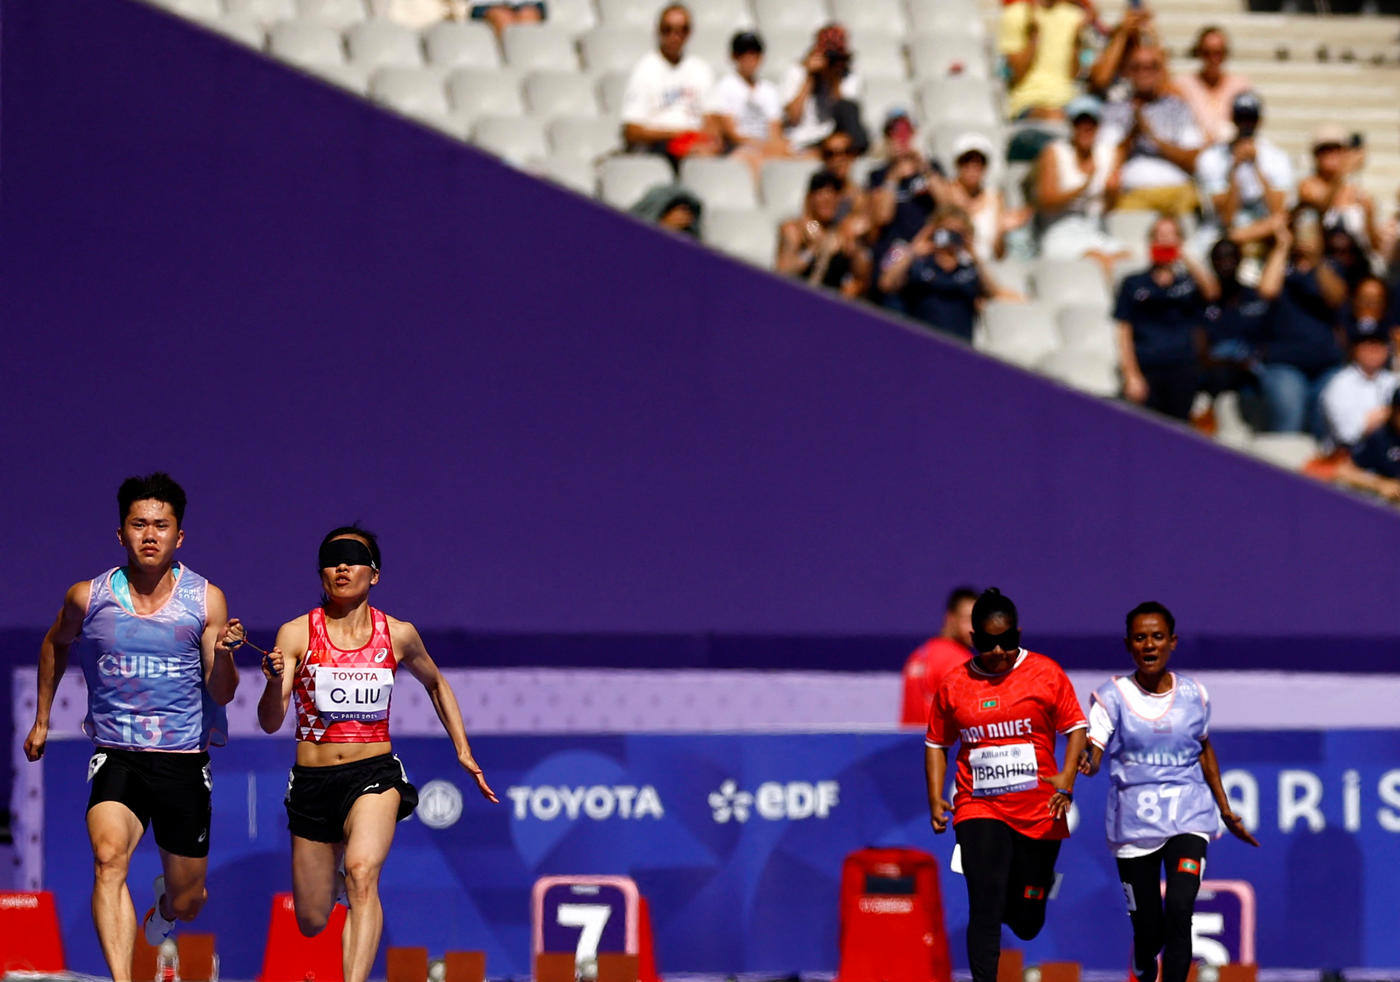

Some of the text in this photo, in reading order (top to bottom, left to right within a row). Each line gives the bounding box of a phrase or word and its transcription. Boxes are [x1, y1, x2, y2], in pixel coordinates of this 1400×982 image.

[97, 653, 182, 679] GUIDE
[331, 671, 379, 681] TOYOTA
[330, 688, 381, 704] C. LIU
[114, 712, 163, 747] 13
[981, 750, 1009, 760] Allianz
[974, 762, 1036, 781] IBRAHIM
[507, 784, 665, 820] TOYOTA
[1136, 786, 1183, 823] 87
[556, 903, 612, 962] 7
[1190, 911, 1231, 967] 5
